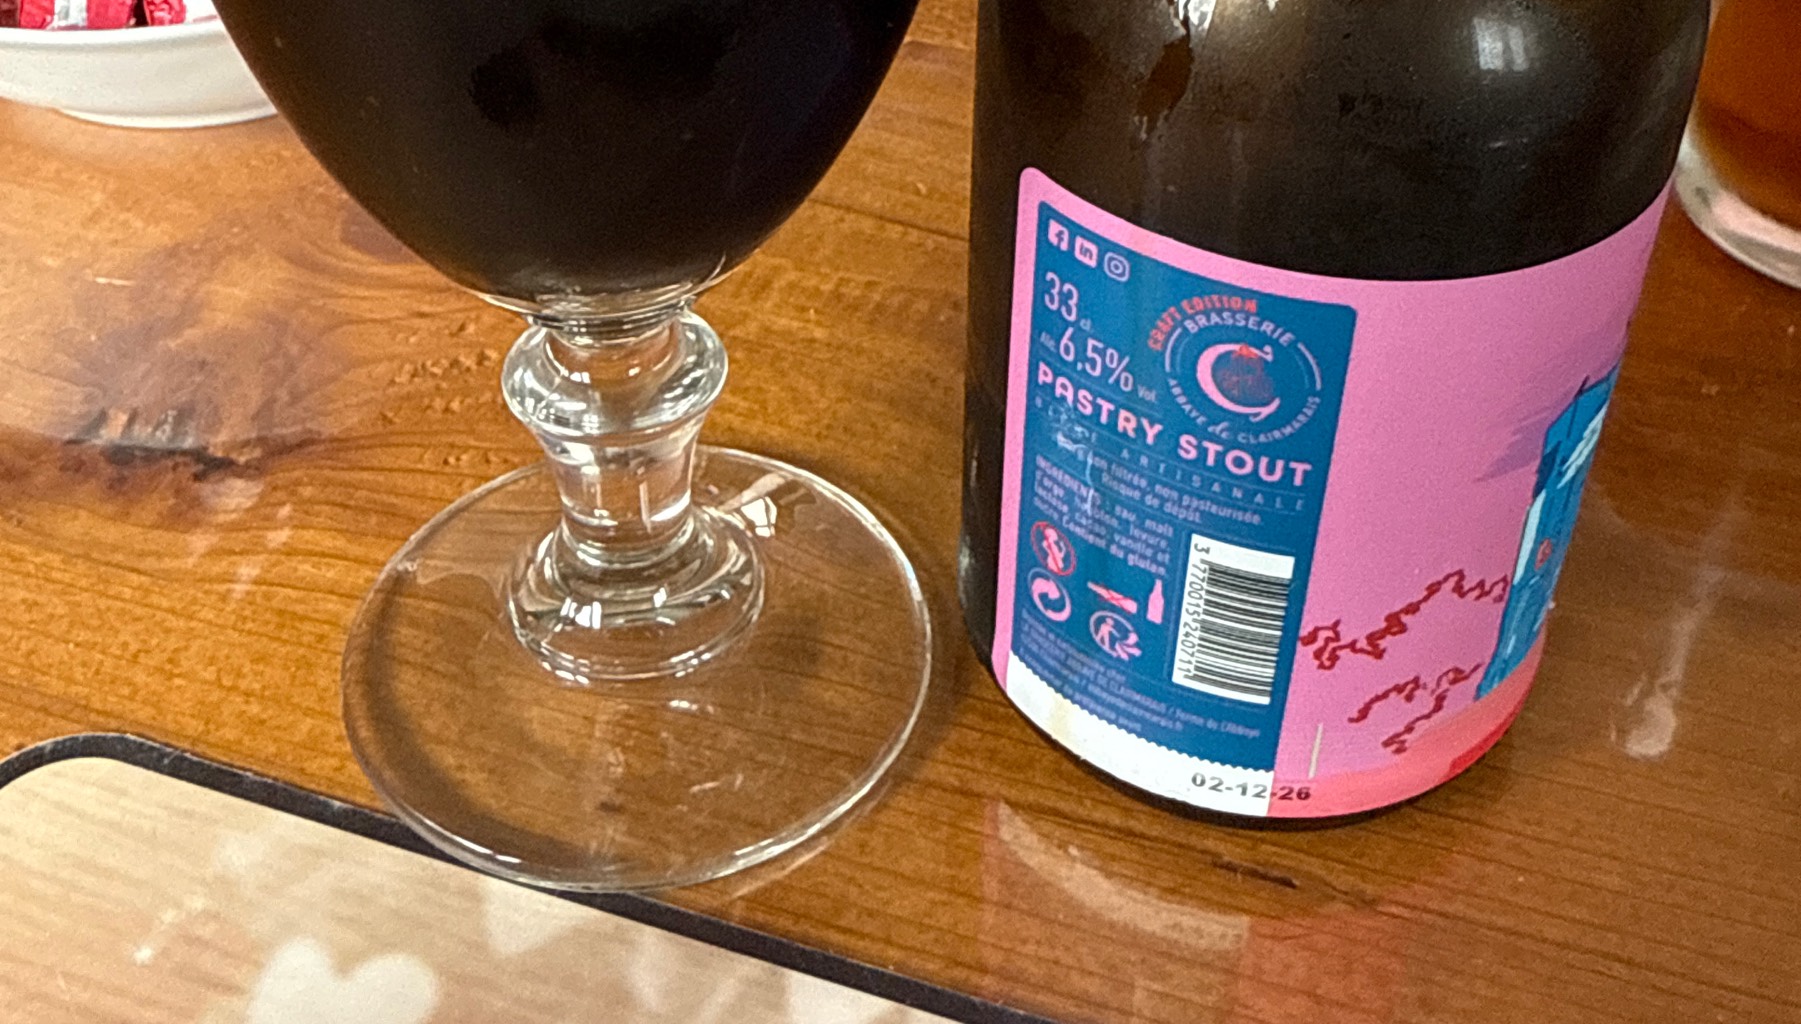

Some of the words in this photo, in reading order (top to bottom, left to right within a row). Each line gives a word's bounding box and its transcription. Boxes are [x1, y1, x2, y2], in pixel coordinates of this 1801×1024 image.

[1044, 271, 1079, 322] 33
[1147, 306, 1182, 351] CRAFT
[1181, 294, 1258, 314] EDITION
[1184, 311, 1296, 348] BRASSERIE
[1037, 361, 1164, 446] PASTRY
[1177, 434, 1313, 486] STOUT
[1168, 378, 1208, 425] ABBAYE
[1237, 396, 1321, 444] CLAIRMARAIS
[1101, 472, 1141, 501] Risque
[1145, 493, 1160, 509] de
[1121, 448, 1304, 511] ARTISANALE
[1155, 483, 1179, 502] non
[1194, 543, 1210, 555] 3
[1185, 563, 1207, 617] 770015
[1177, 621, 1199, 677] 240711
[1191, 772, 1311, 801] 02-12-26
